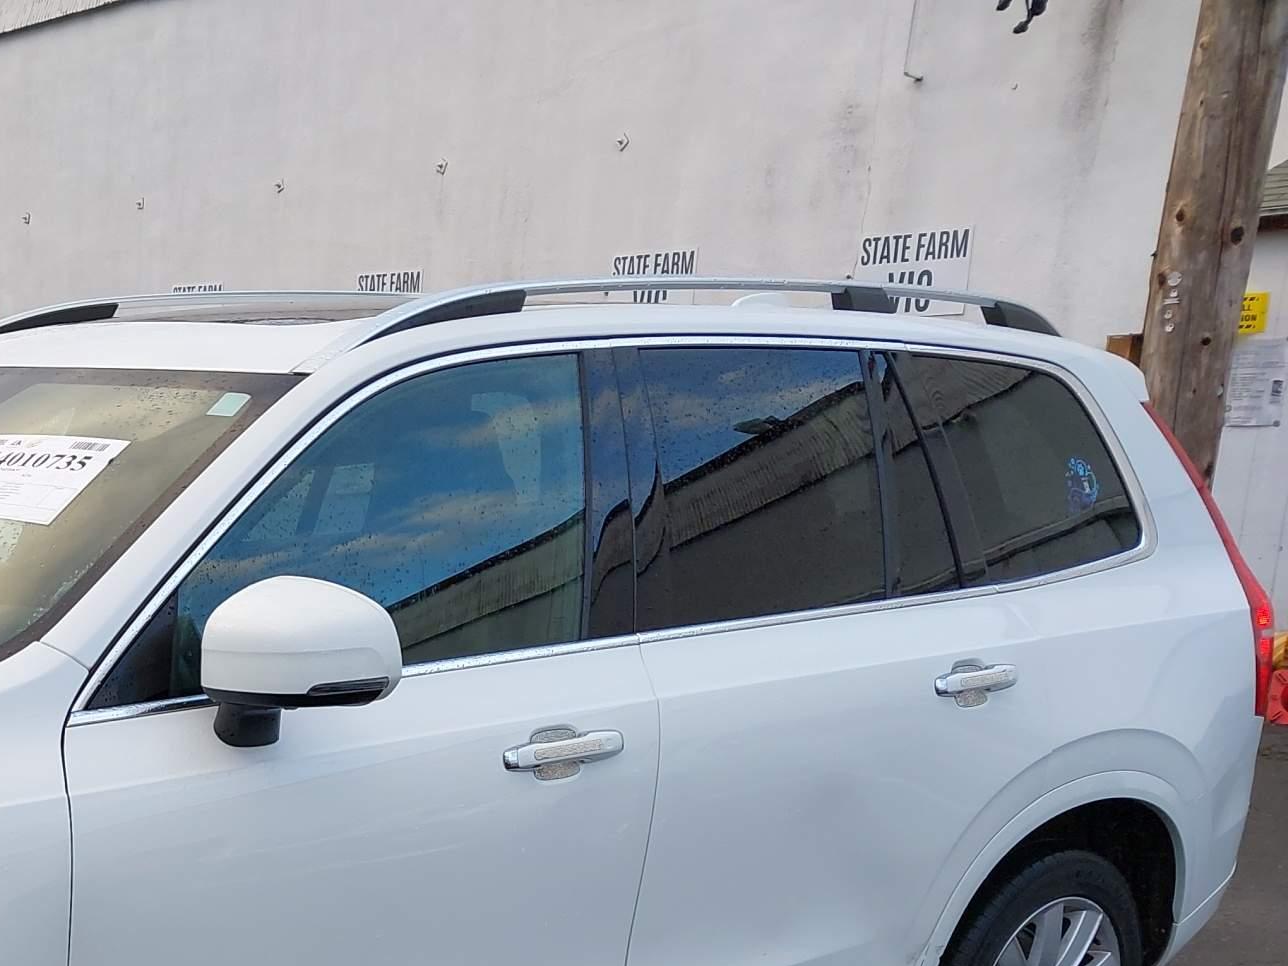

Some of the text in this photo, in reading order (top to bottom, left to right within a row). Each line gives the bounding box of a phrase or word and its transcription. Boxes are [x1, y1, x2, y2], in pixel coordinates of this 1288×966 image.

[860, 228, 970, 266] STATE FARM
[653, 250, 695, 275] FARM
[390, 271, 421, 293] FARM
